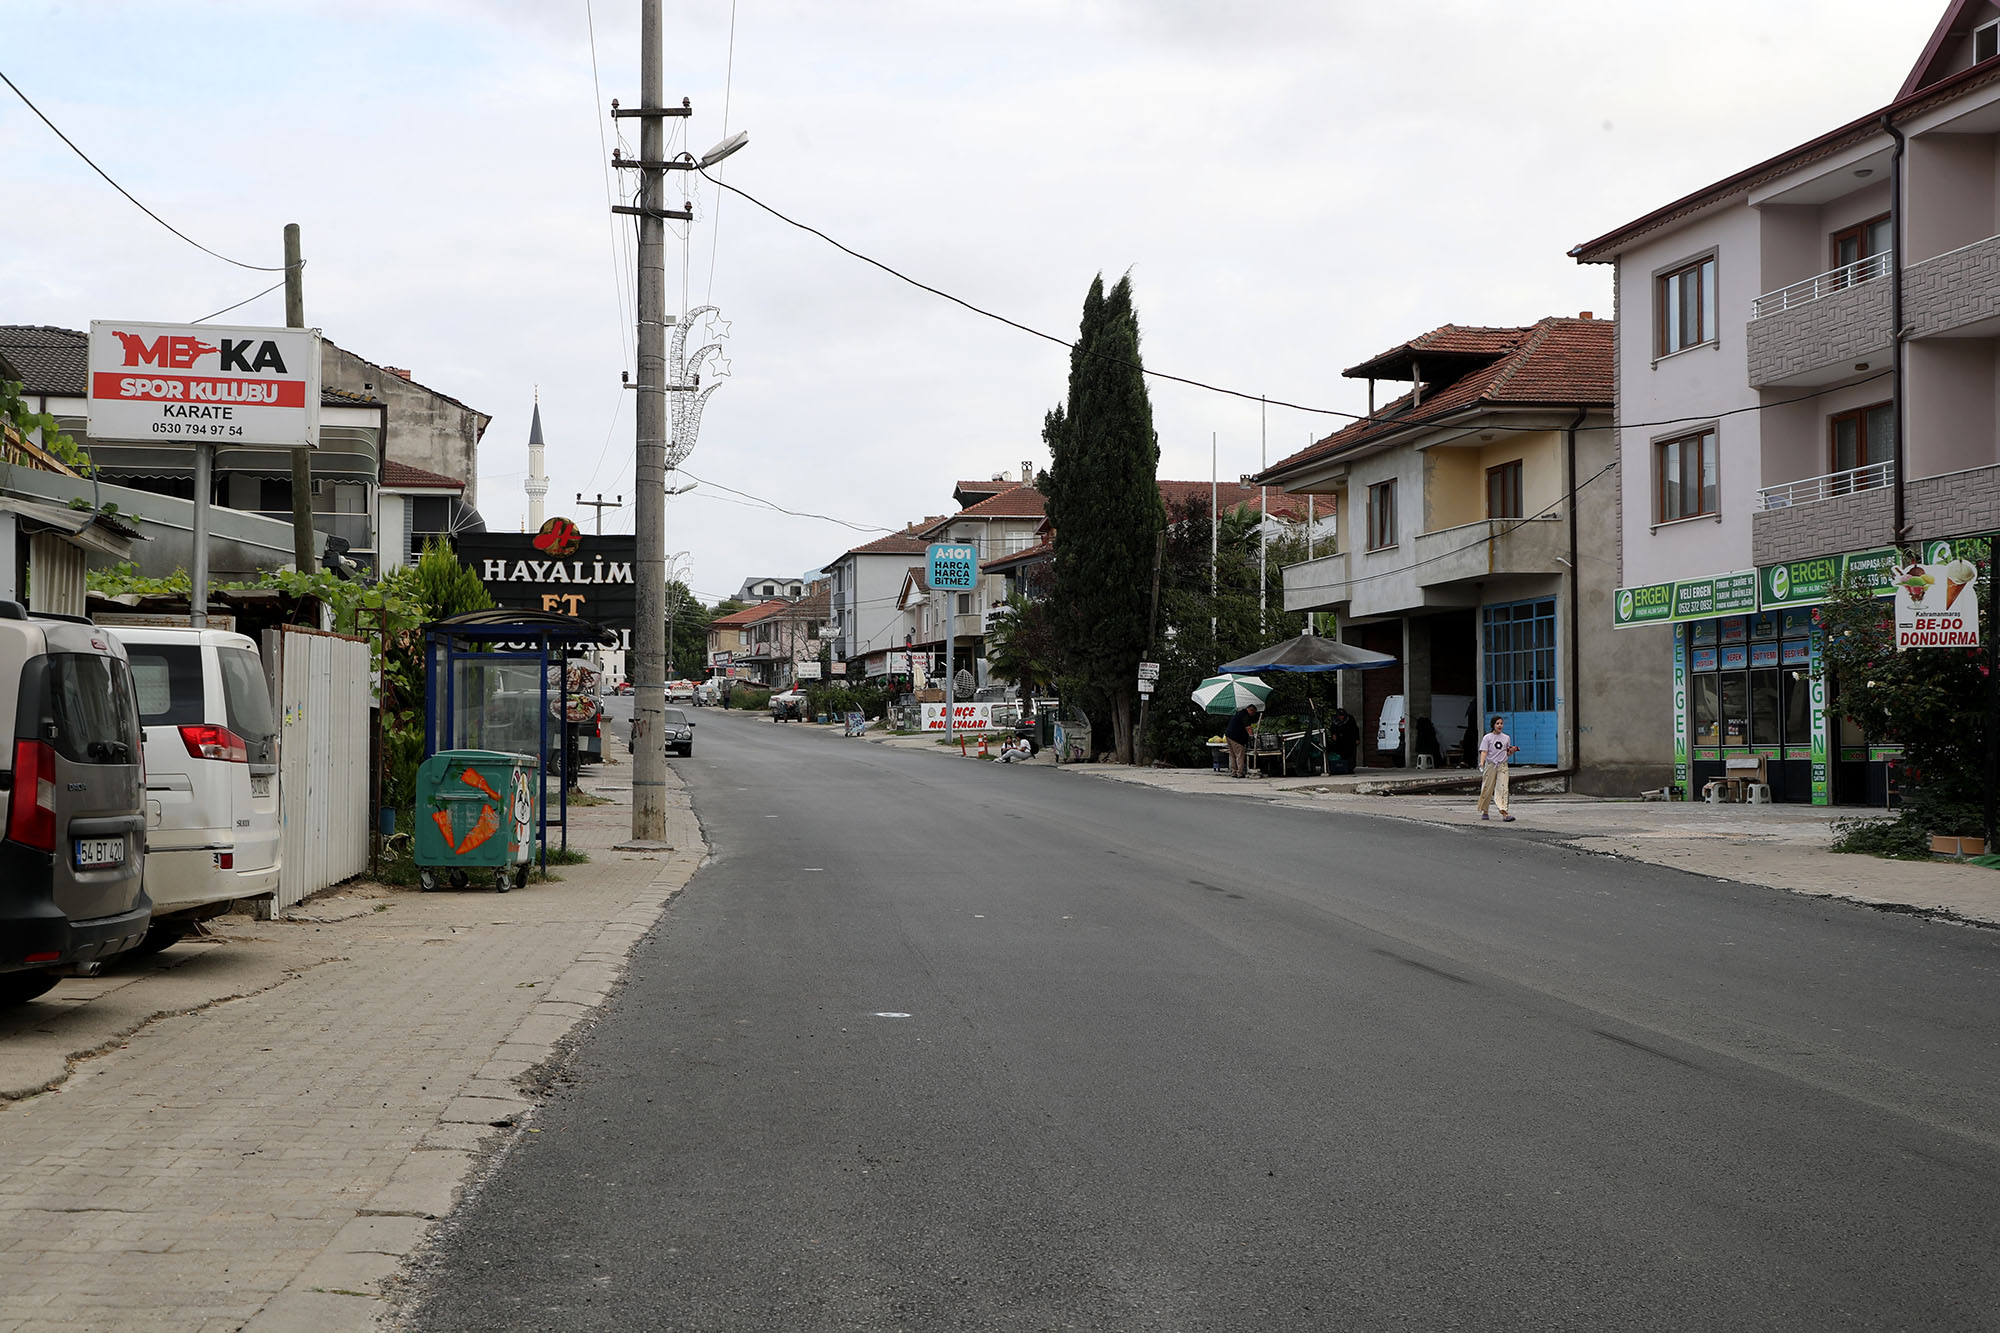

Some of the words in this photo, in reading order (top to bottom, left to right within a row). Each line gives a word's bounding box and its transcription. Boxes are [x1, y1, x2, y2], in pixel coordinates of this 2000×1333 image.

[120, 377, 184, 399] SPOR
[163, 404, 233, 420] KARATE
[152, 422, 181, 433] 0530
[185, 423, 206, 435] 794
[210, 425, 225, 436] 97
[229, 426, 243, 436] 54
[935, 561, 970, 570] HARCA
[935, 569, 970, 577] HARCA
[1791, 559, 1835, 584] ERGEN
[1635, 586, 1669, 606] ERGEN
[1693, 585, 1712, 599] ERGEN
[541, 593, 586, 616] ET
[1915, 618, 1963, 630] BE-DO
[1900, 631, 1977, 646] DONDURMA
[940, 706, 976, 719] BHÇE
[81, 843, 93, 862] 54
[96, 842, 107, 861] BT
[109, 842, 122, 861] 420
